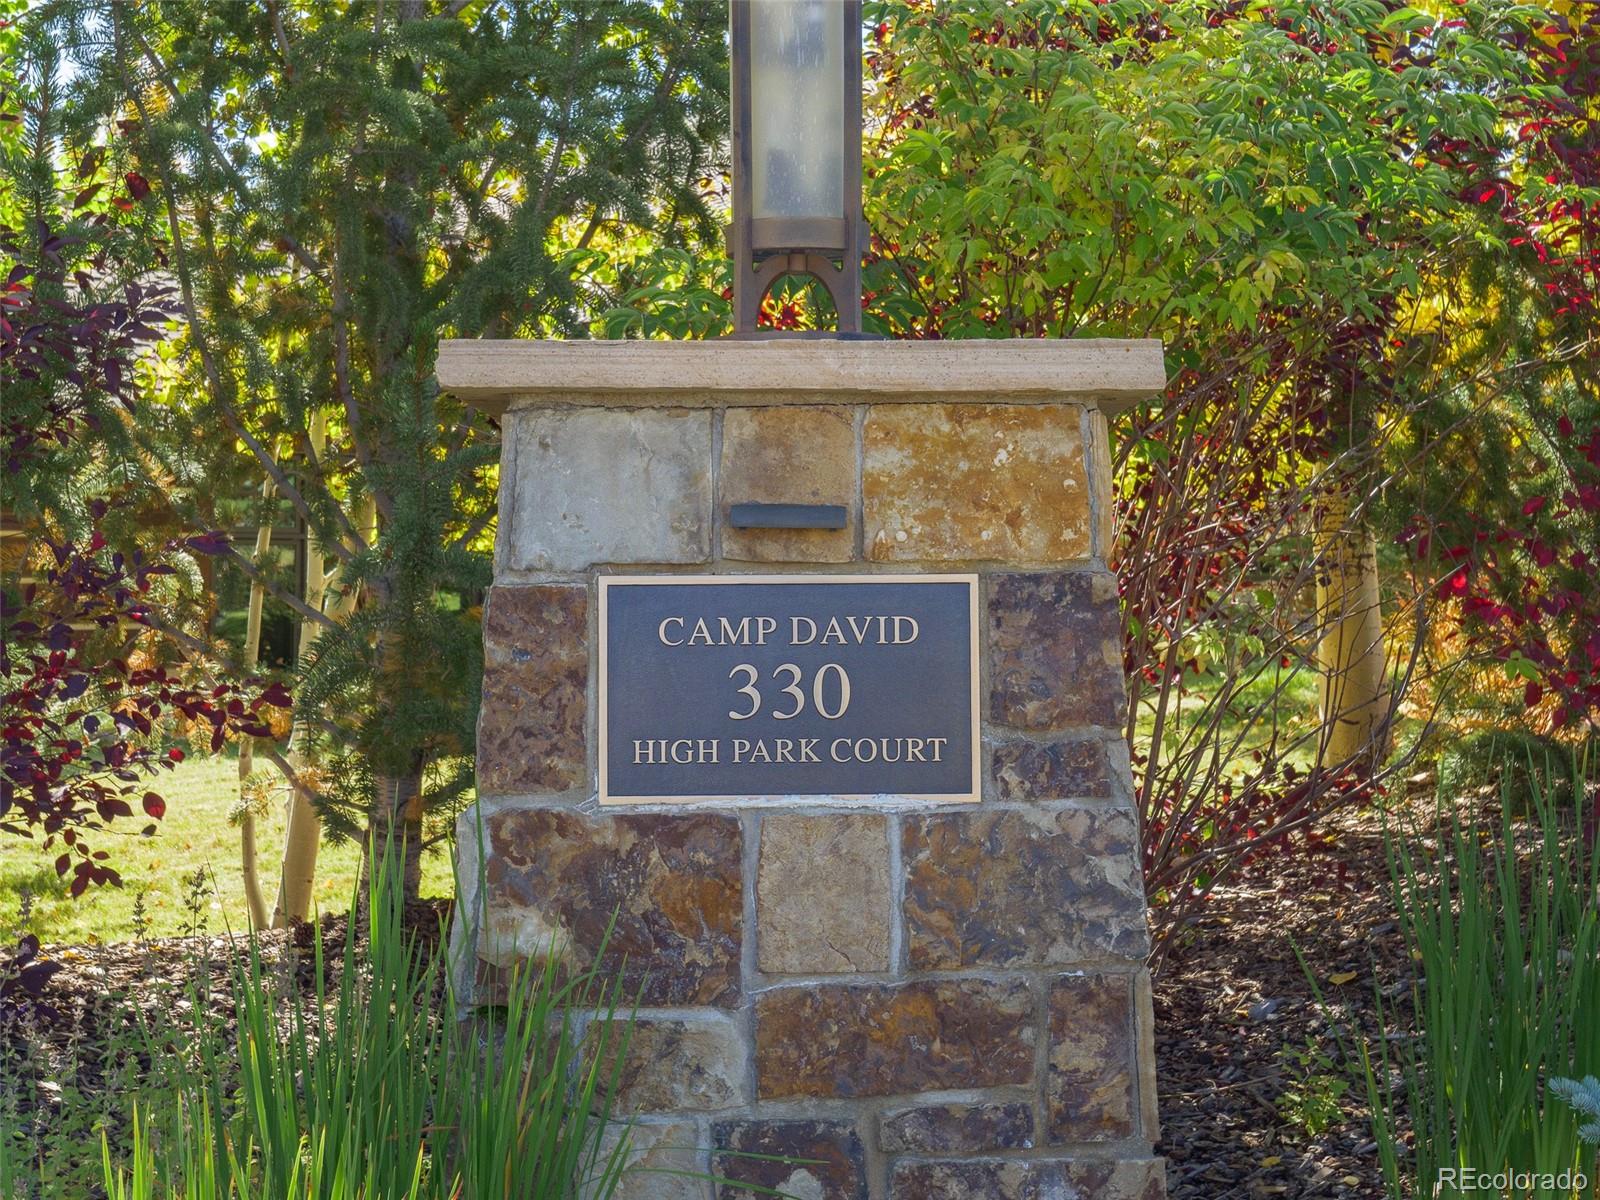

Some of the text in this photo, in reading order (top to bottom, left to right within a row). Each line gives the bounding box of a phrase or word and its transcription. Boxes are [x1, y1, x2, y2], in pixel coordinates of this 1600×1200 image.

[658, 616, 919, 646] CAMP DAVID
[728, 663, 851, 720] 330
[632, 737, 947, 764] HIGH PARK COURT
